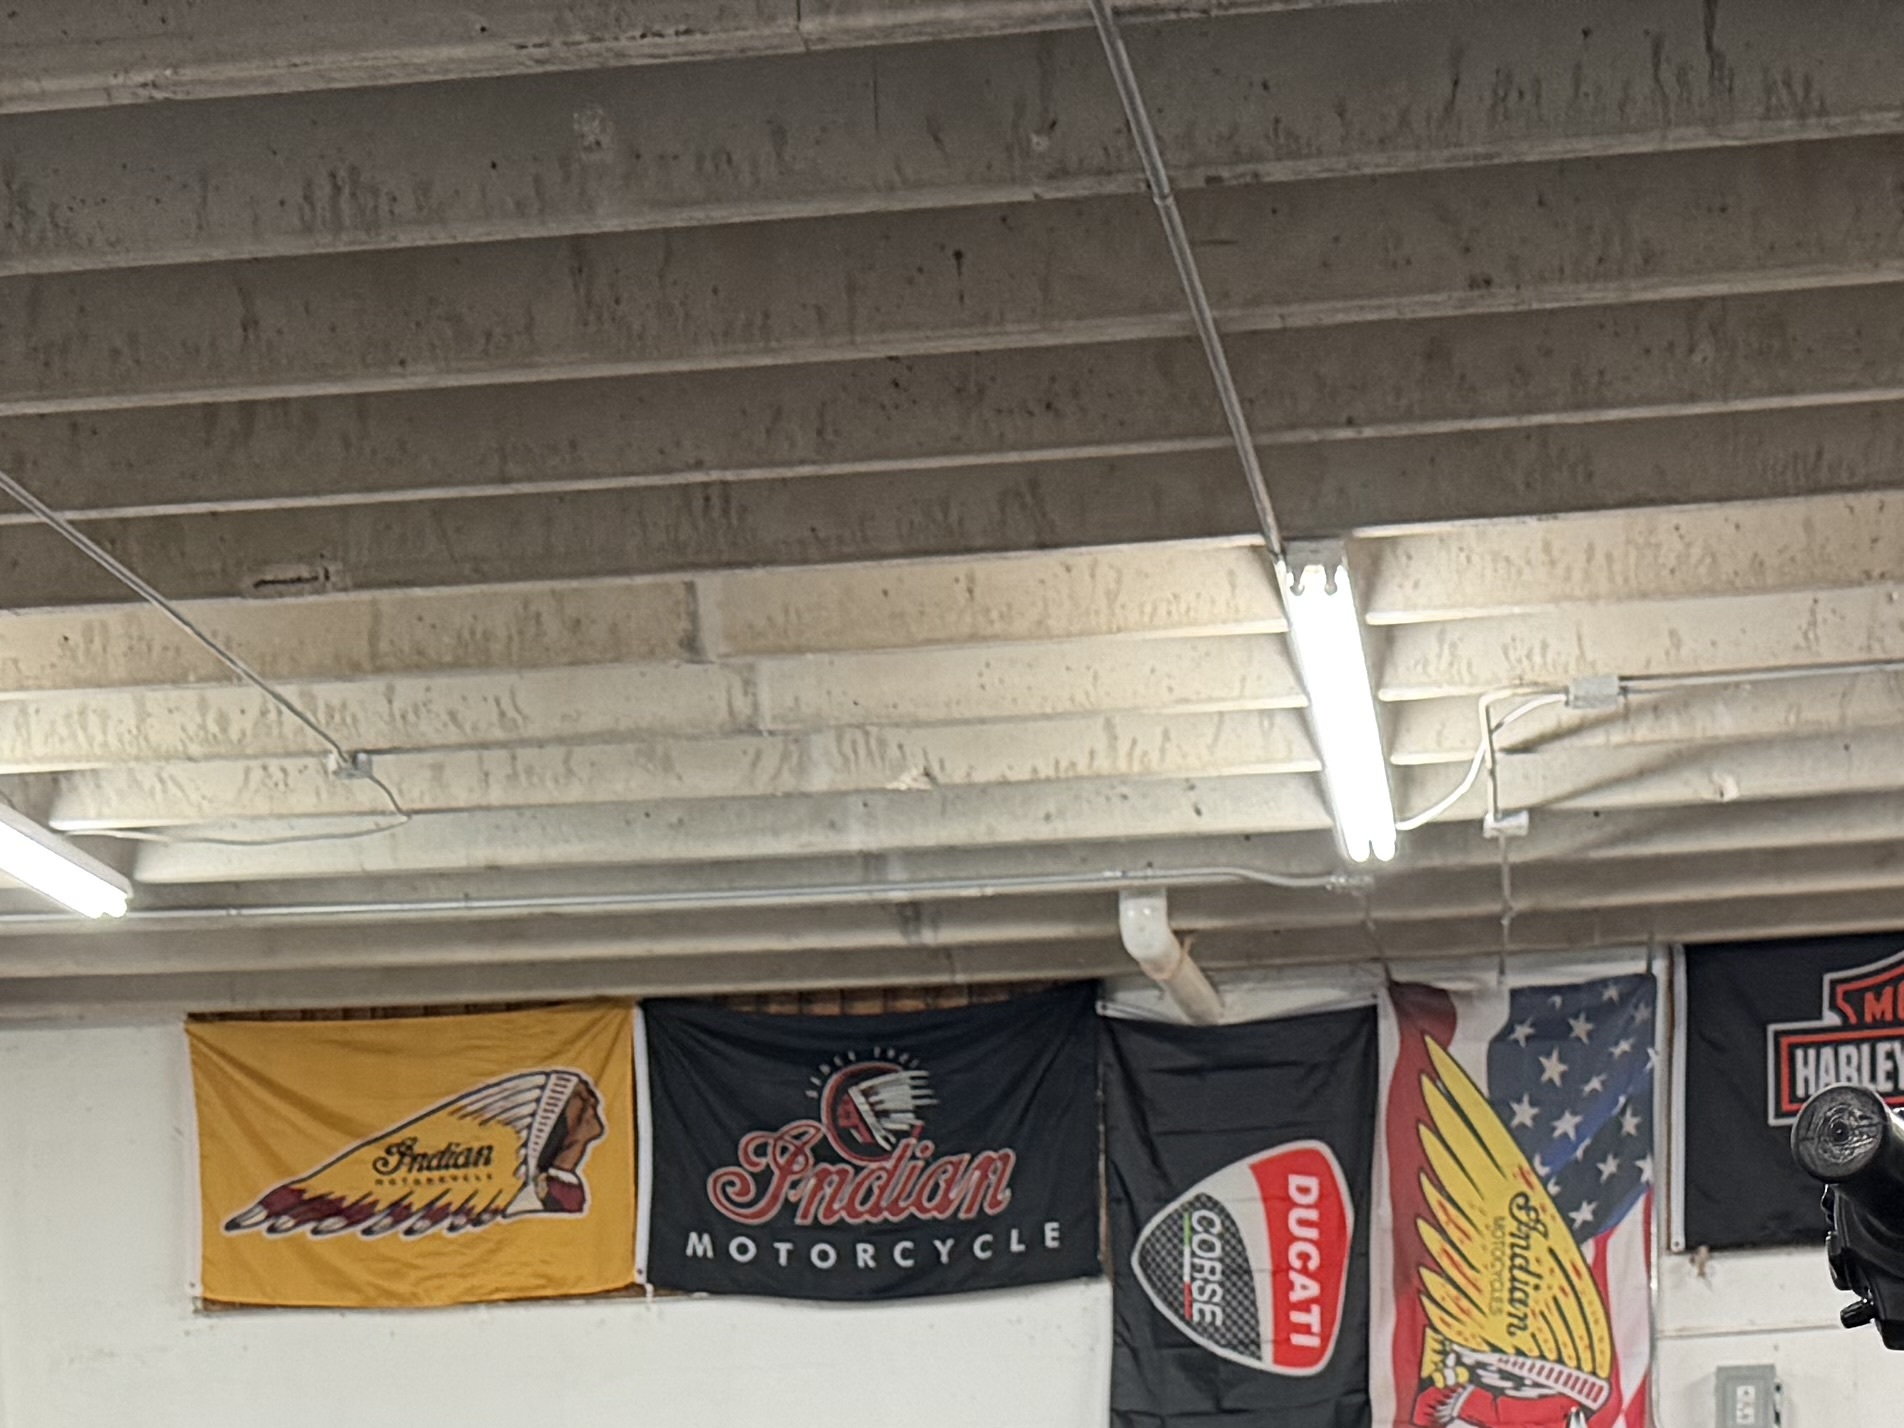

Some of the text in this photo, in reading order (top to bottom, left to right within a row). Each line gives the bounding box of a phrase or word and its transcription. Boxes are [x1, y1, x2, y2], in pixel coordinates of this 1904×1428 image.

[372, 1136, 494, 1175] Indian
[707, 1119, 1016, 1225] Indian
[686, 1222, 1060, 1269] MOTORCYCLE
[1191, 1209, 1223, 1327] CORSE
[1288, 1174, 1321, 1348] DUCATI
[1506, 1191, 1549, 1338] Indian
